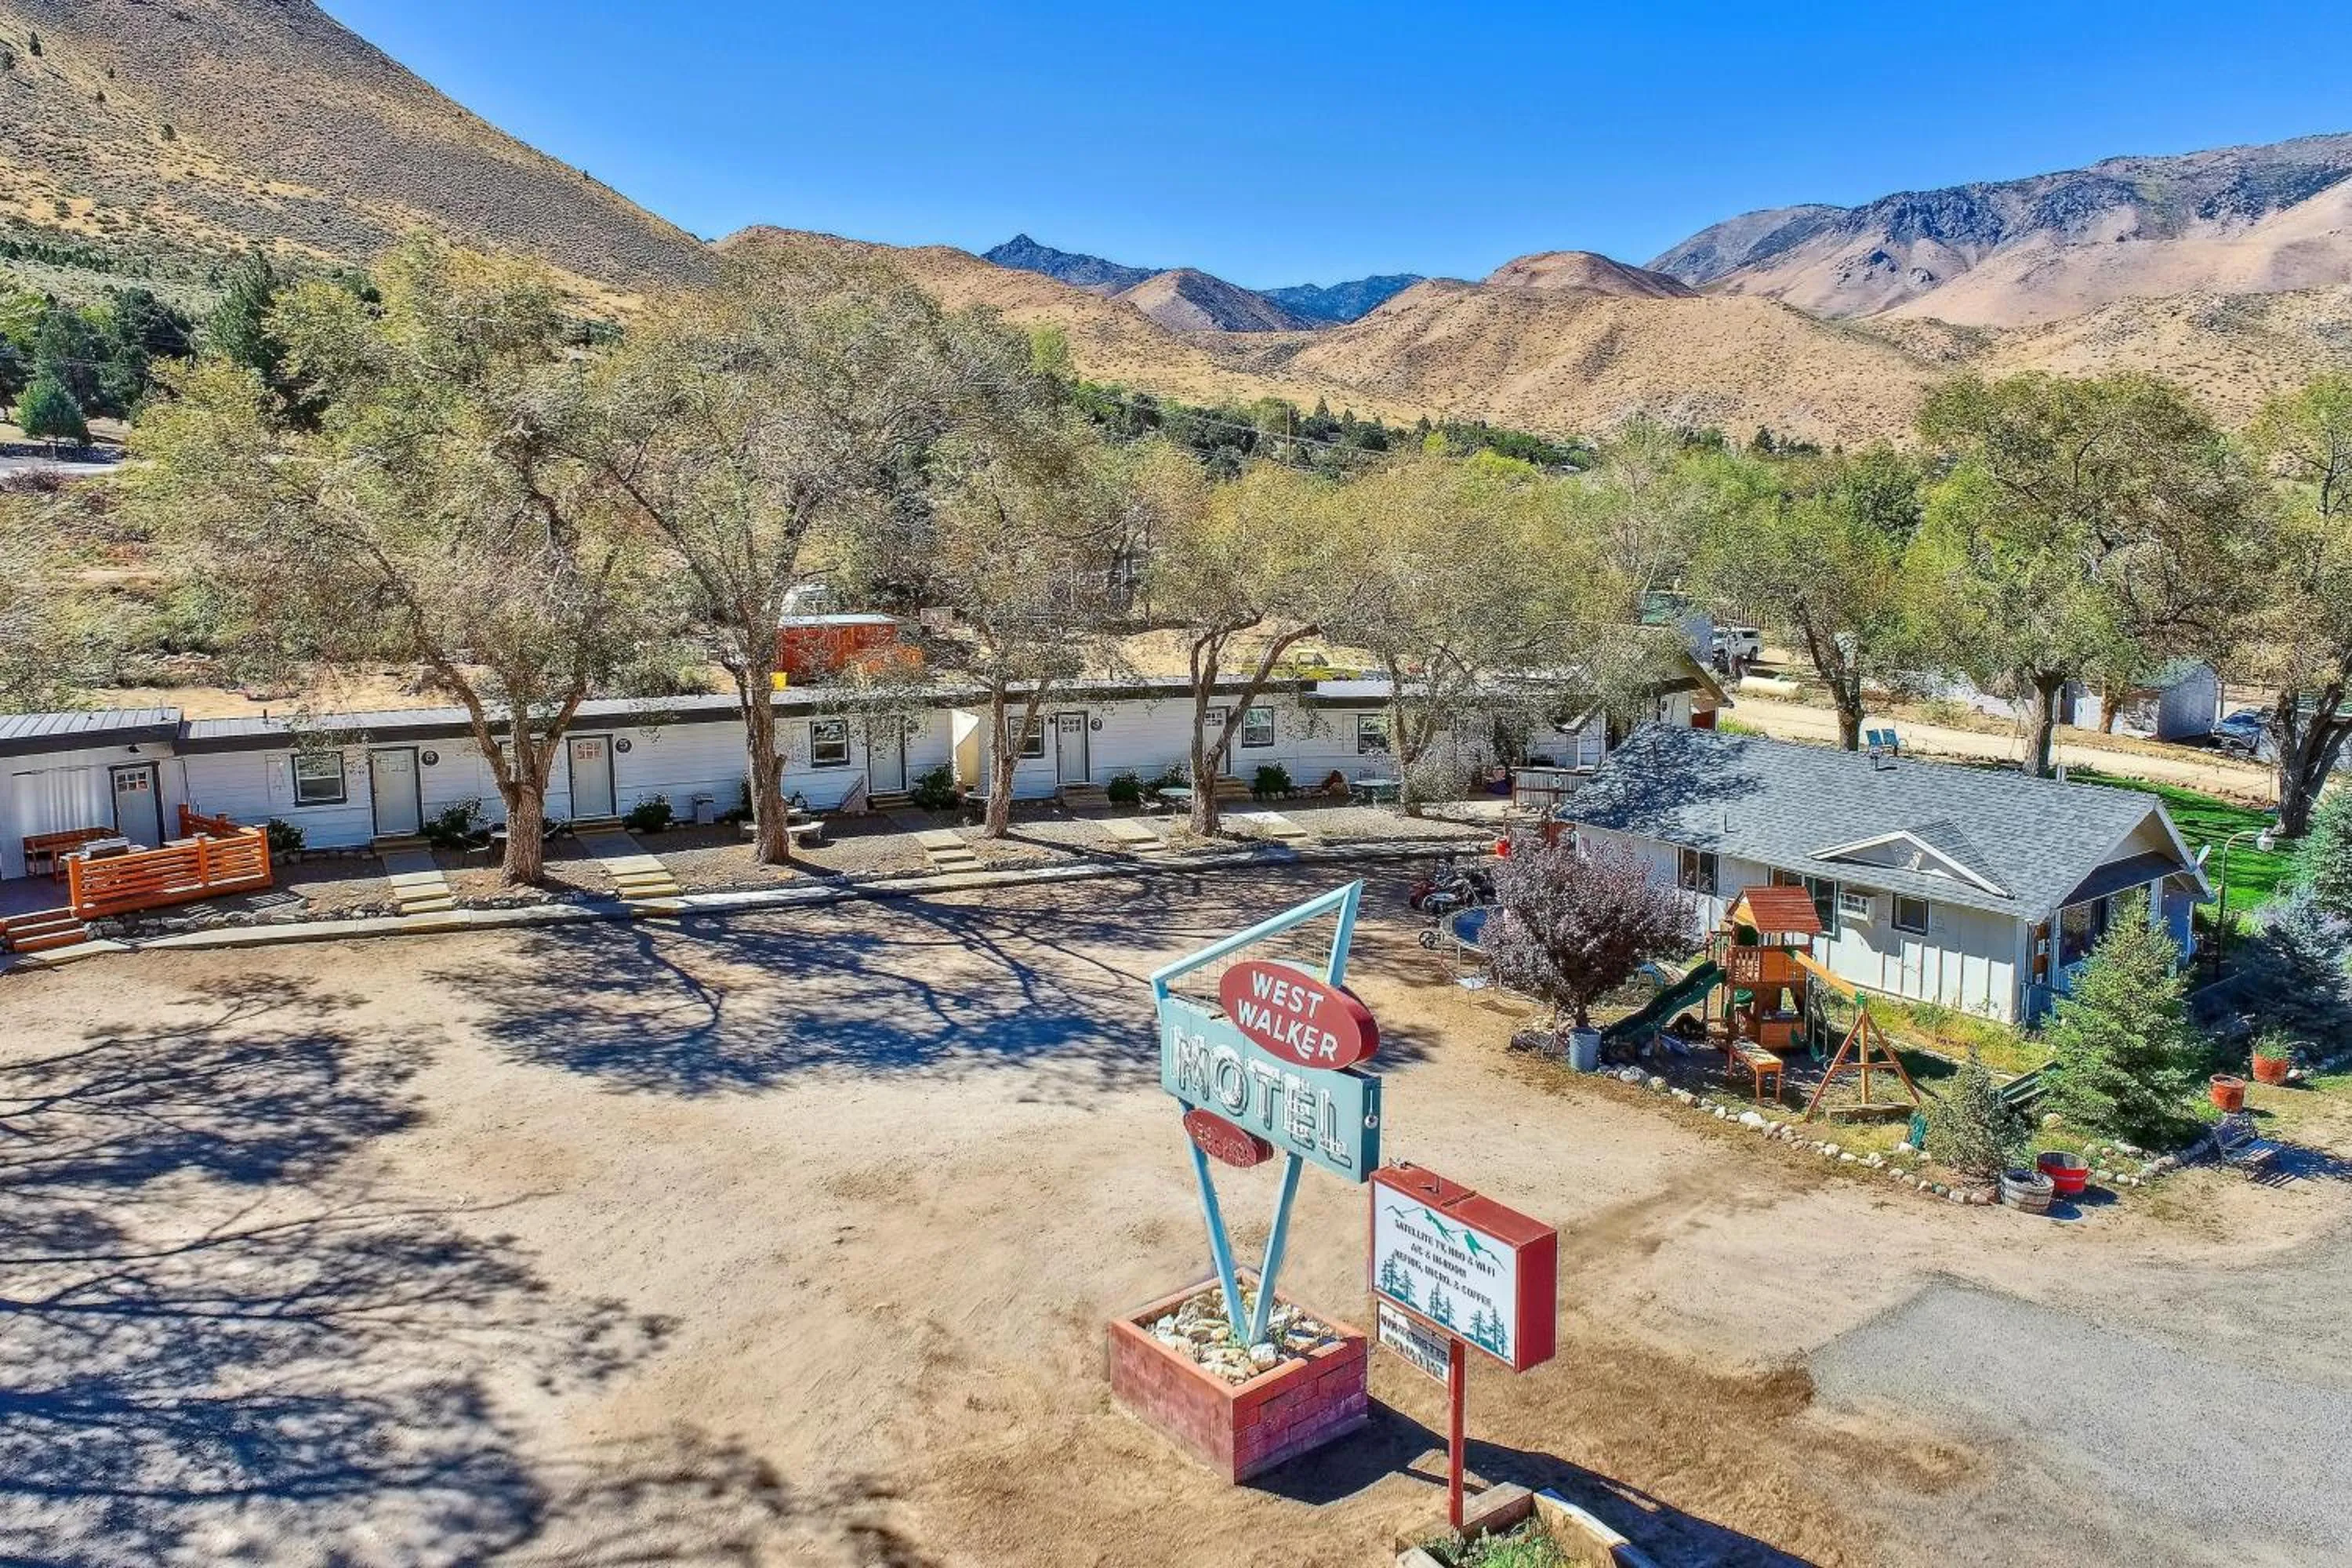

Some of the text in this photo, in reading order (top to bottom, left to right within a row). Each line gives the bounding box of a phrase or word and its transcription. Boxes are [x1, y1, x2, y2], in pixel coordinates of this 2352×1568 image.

[1252, 970, 1324, 1018] WEST
[1238, 999, 1338, 1062] WALKER
[1169, 1025, 1352, 1170] MOTEL
[1395, 1219, 1434, 1246] SATELLITE
[1461, 1285, 1492, 1307] COFFEE
